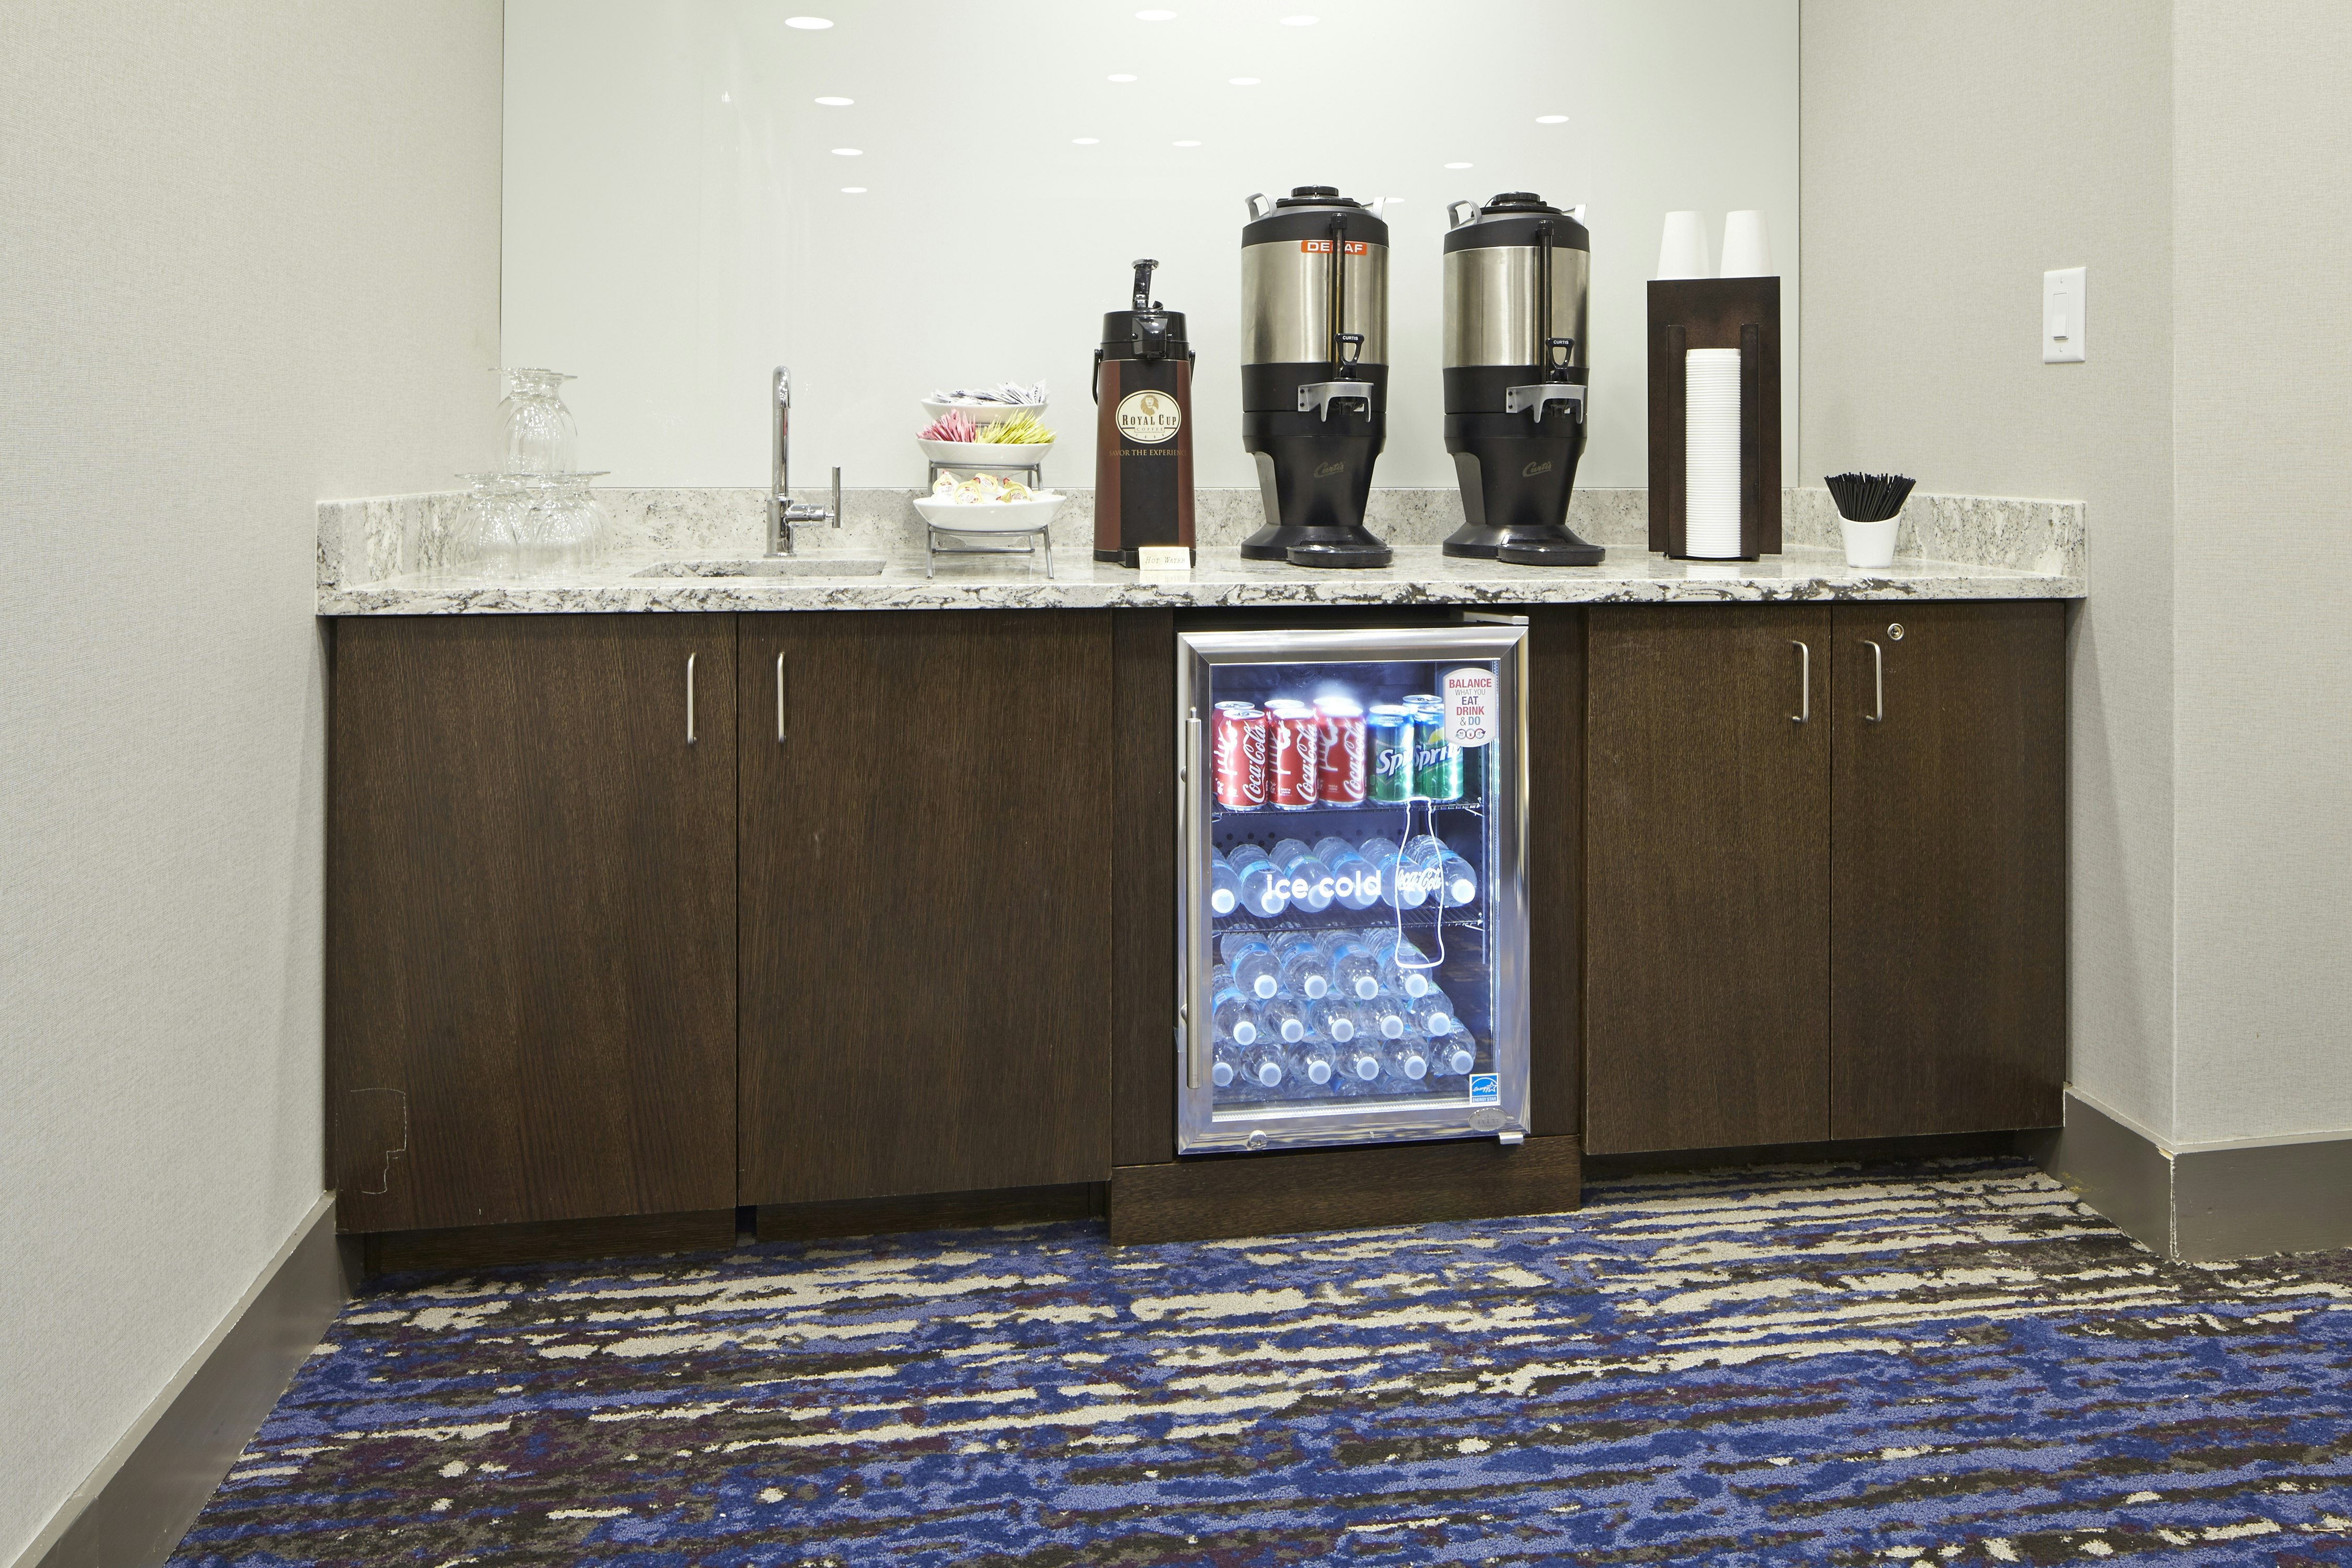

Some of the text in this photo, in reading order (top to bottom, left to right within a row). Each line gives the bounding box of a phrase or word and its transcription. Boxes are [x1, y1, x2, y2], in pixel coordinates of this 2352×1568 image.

[1307, 242, 1363, 252] DEAF
[1122, 414, 1176, 425] ROYAL CUP
[1313, 462, 1344, 478] Curtis
[1522, 461, 1551, 477] Curtis
[1449, 678, 1491, 688] BALANCE
[1456, 706, 1485, 716] DRINK
[1460, 716, 1481, 726] & DO
[1243, 720, 1266, 803] Coca-Cola
[1266, 870, 1381, 900] ice cold
